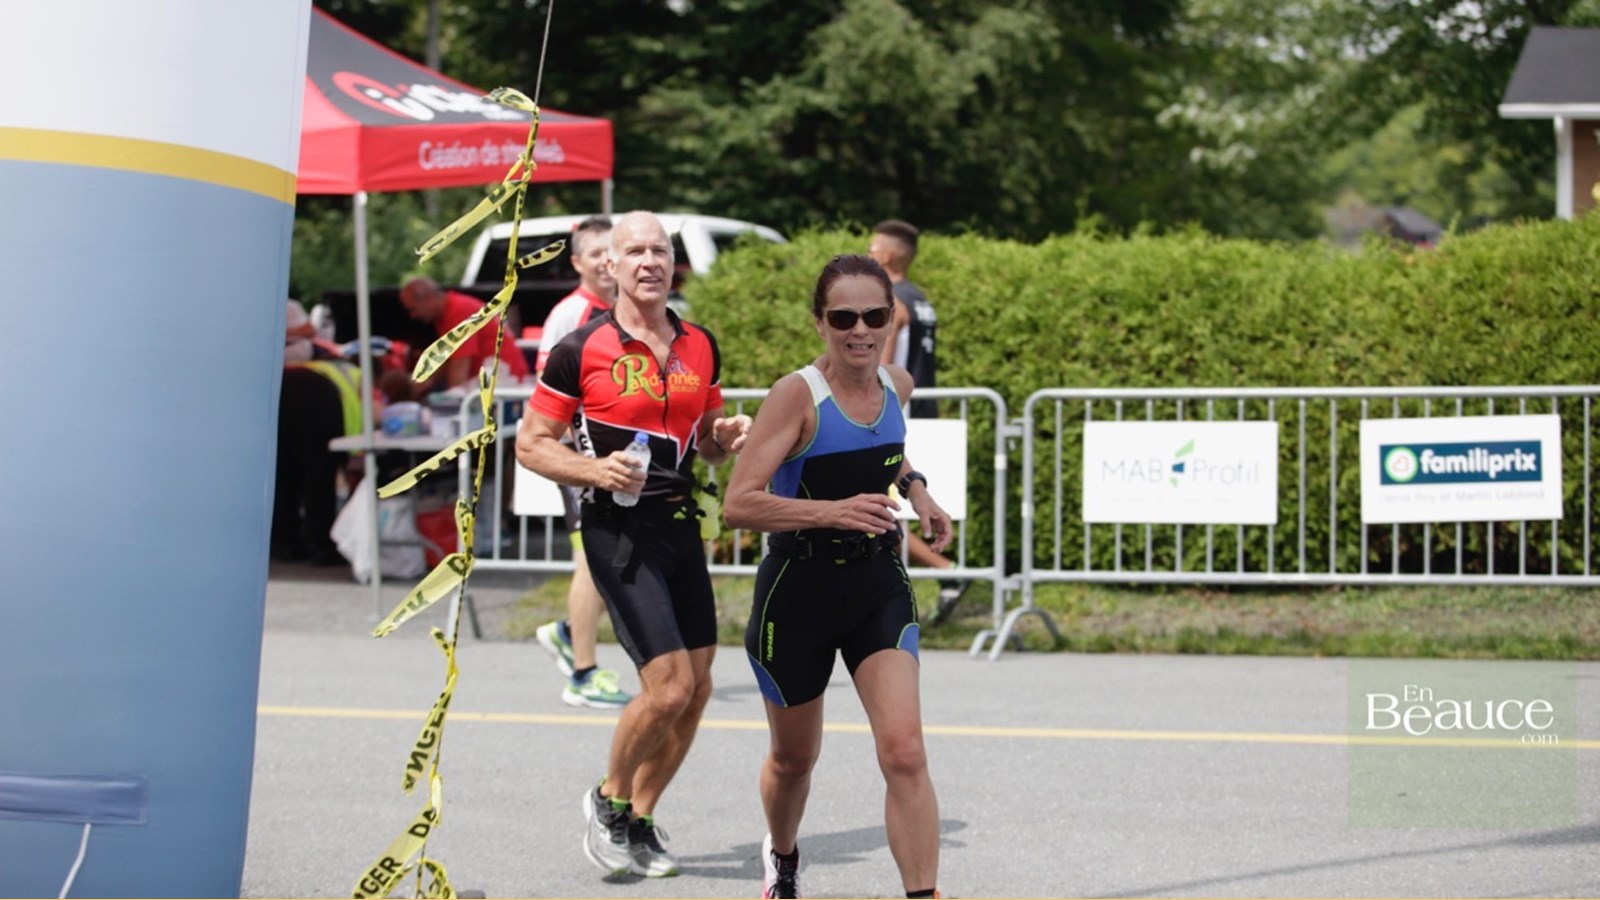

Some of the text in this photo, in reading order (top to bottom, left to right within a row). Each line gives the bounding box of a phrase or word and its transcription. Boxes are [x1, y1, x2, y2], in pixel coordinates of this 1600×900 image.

[1101, 458, 1259, 485] MAB Profil
[1420, 447, 1537, 479] familiprix
